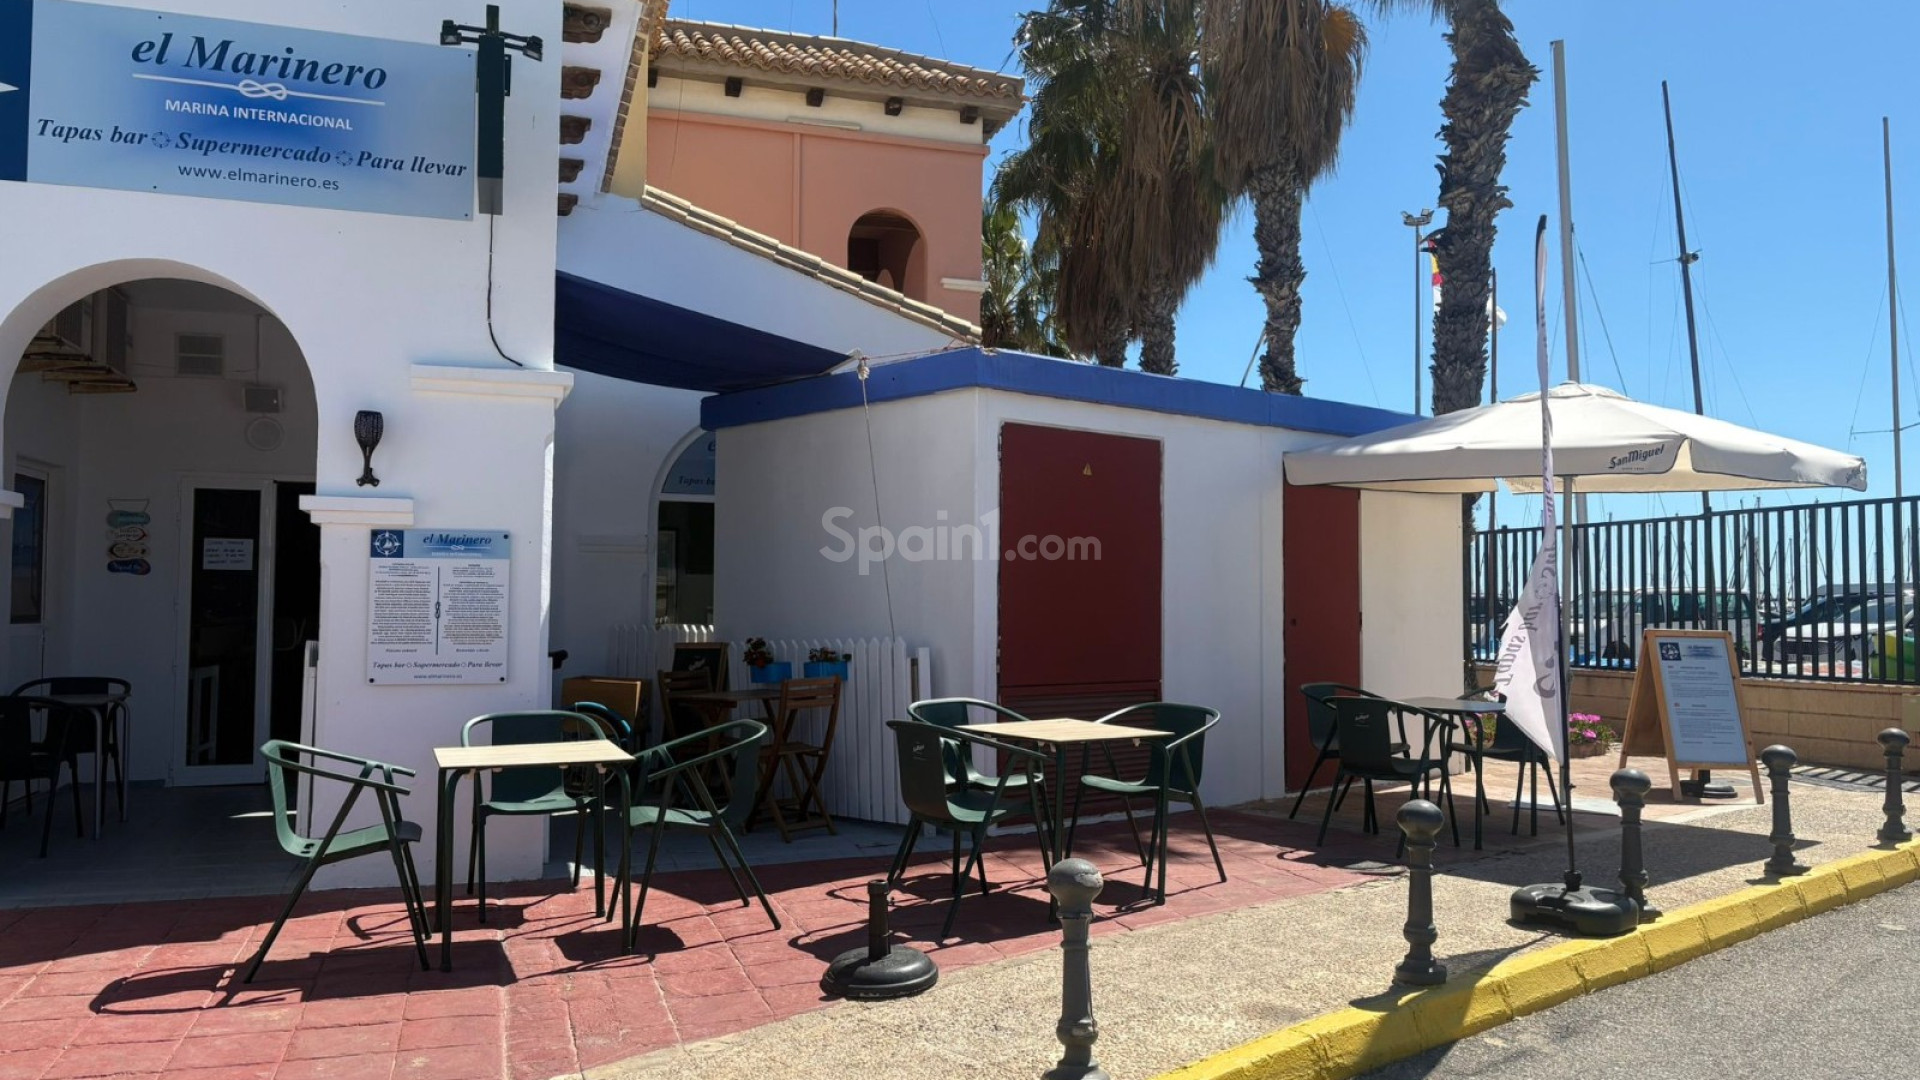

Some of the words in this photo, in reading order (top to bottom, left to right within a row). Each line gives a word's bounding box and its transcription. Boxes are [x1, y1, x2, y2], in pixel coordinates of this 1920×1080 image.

[131, 33, 173, 65] el
[181, 36, 387, 90] Marinero
[165, 99, 229, 118] MARINA
[233, 106, 354, 131] INTERNACIONAL
[37, 118, 103, 144] Tapas
[109, 125, 149, 145] bar
[175, 131, 331, 164] Supermercado
[356, 150, 404, 171] Para
[410, 155, 467, 177] llevar
[178, 164, 340, 191] www.elmarinero.es
[708, 441, 715, 451] e
[423, 533, 433, 544] el
[438, 533, 492, 545] Marinero
